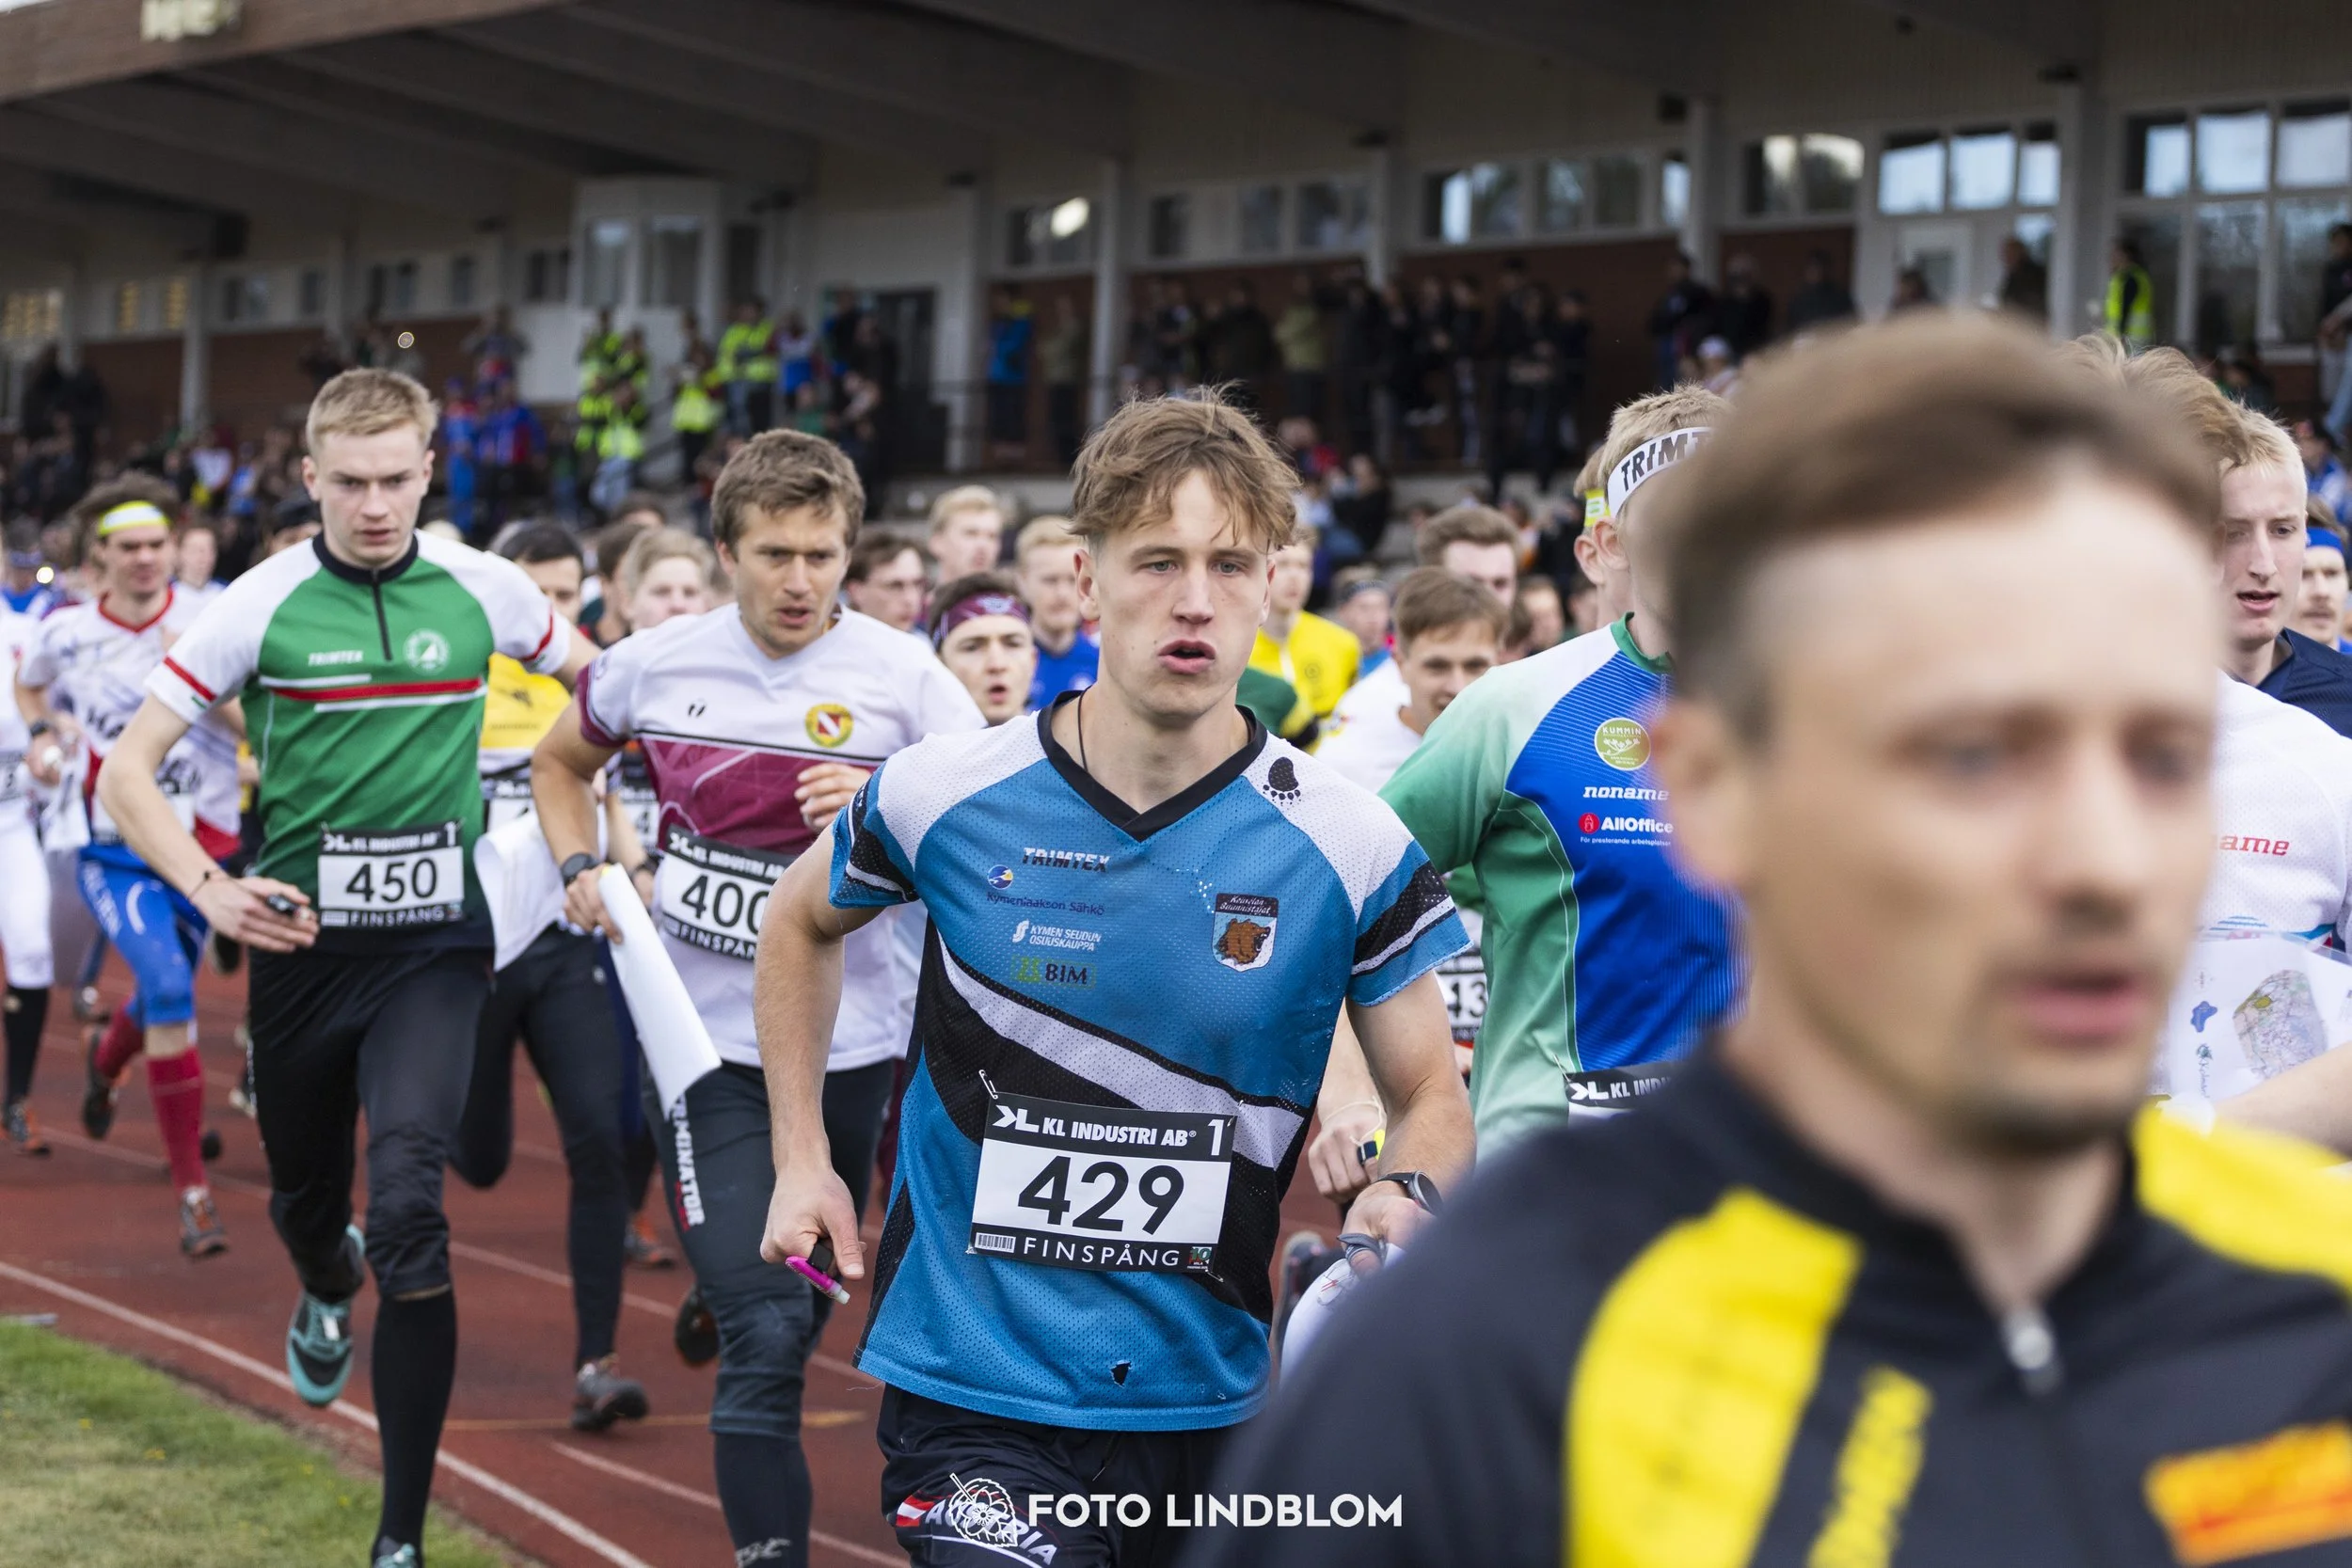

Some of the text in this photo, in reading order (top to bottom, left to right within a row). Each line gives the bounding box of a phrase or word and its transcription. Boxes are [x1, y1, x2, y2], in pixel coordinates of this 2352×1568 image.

[1602, 726, 1642, 736] KUMMIN
[1582, 786, 1670, 800] noname
[1601, 816, 1675, 833] AllOffice
[1022, 847, 1111, 873] TRIMTEX
[346, 858, 437, 903] 450
[1069, 901, 1105, 916] Sähkö
[1030, 925, 1103, 942] KYMEN SEUDUN
[1029, 935, 1095, 952] OSUUSKAUPPA
[1045, 963, 1088, 984] BIM
[1610, 1082, 1630, 1099] KL
[1042, 1117, 1066, 1136] KL
[1071, 1121, 1157, 1146] INDUSTRI
[1208, 1118, 1225, 1156] 1
[1017, 1156, 1185, 1236] 429
[1024, 1237, 1180, 1266] FINSPÅNG
